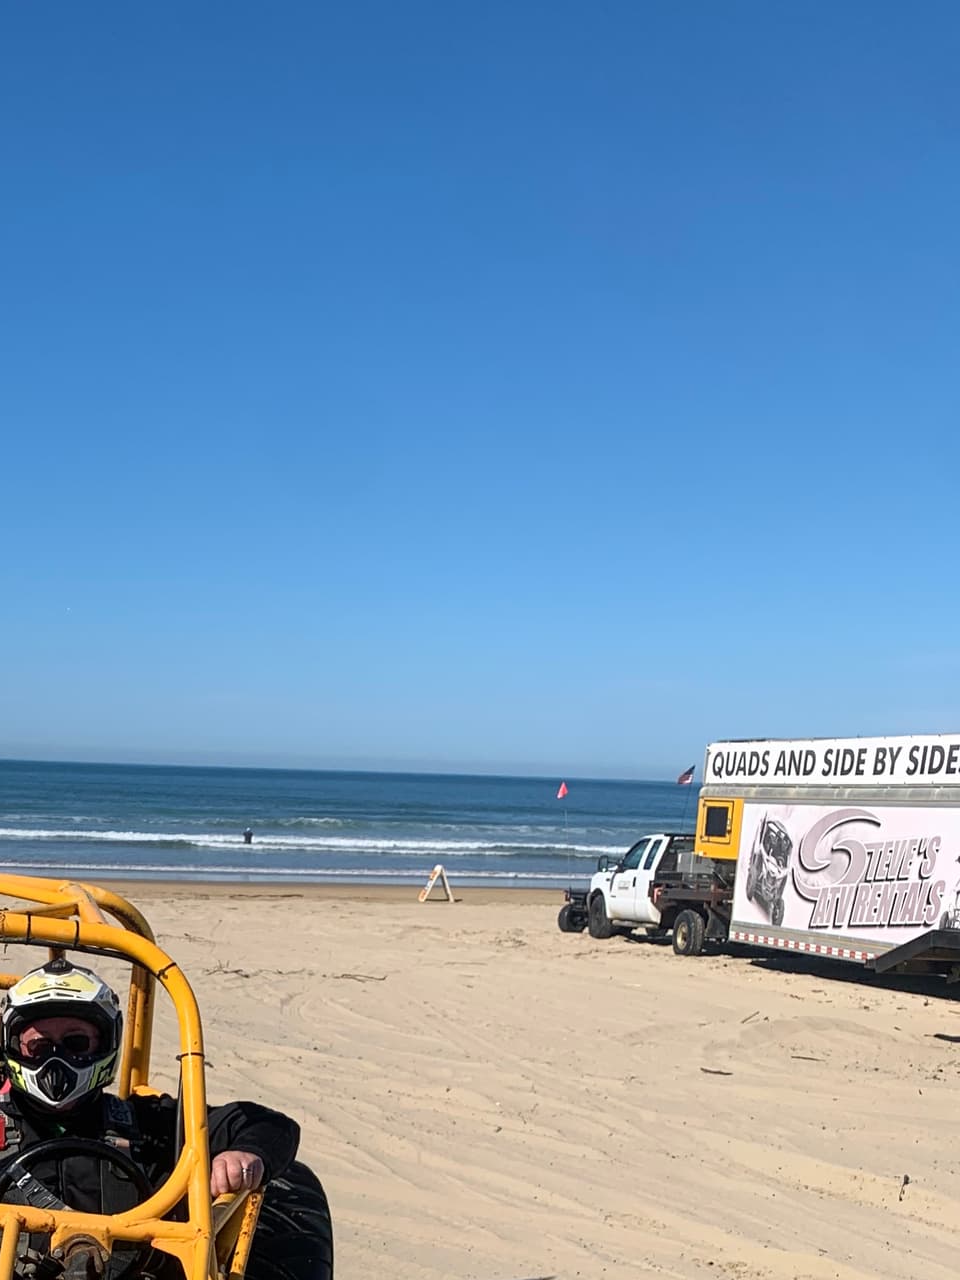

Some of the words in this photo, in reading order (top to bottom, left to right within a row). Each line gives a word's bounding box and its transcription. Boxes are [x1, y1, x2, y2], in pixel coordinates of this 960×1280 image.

[712, 750, 770, 778] QUADS
[774, 750, 817, 777] AND
[821, 748, 868, 777] SIDE
[872, 746, 903, 776] BY
[905, 744, 960, 776] SIDE
[809, 885, 856, 929] ATV
[848, 880, 946, 928] RENTALS
